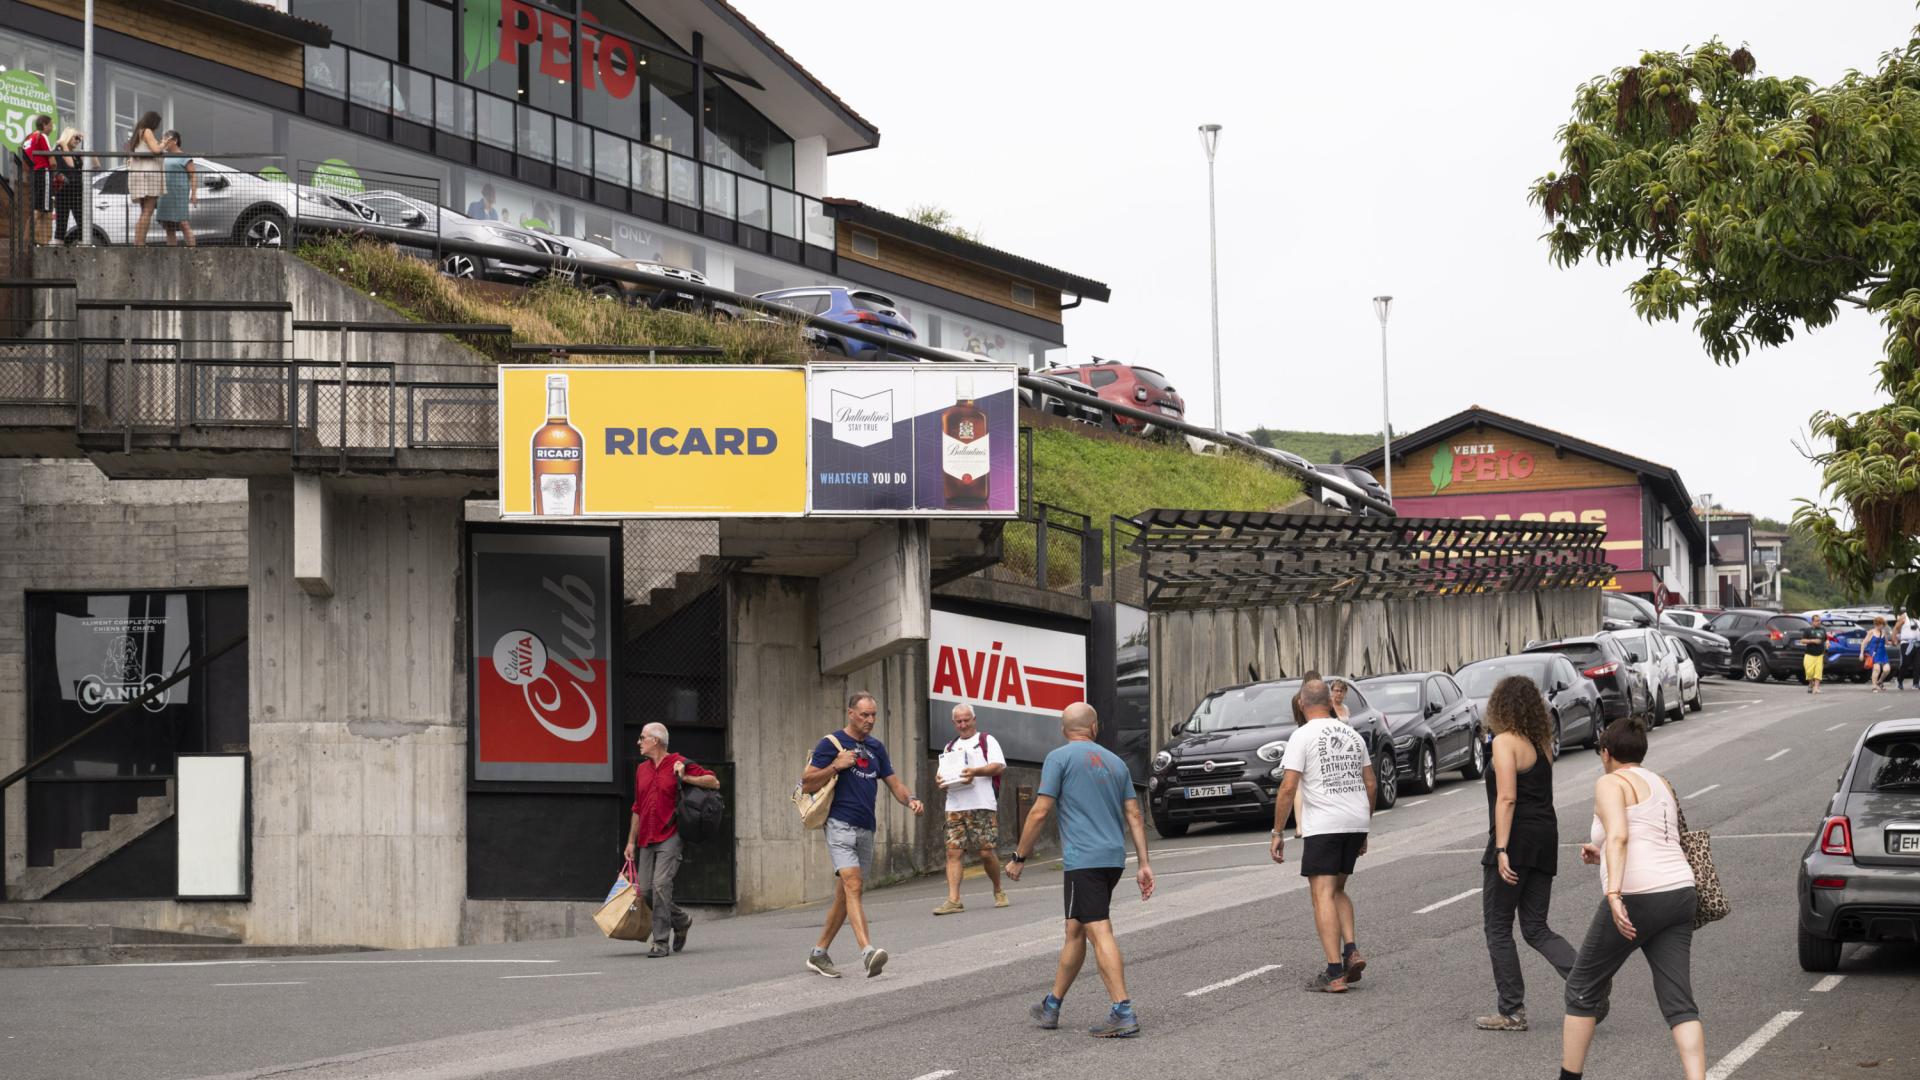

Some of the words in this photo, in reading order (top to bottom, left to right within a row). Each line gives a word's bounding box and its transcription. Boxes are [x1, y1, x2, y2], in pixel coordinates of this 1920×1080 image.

[619, 224, 653, 245] ONLY
[836, 406, 889, 422] Ballantine's
[848, 423, 861, 432] STAY
[863, 423, 878, 432] TRUE
[605, 427, 778, 456] RICARD
[1453, 444, 1496, 455] VENTA
[537, 450, 579, 458] RICARD
[820, 472, 869, 485] WHATEVER
[872, 472, 891, 485] YOU
[894, 472, 907, 485] DO
[504, 649, 519, 681] Club
[523, 574, 598, 742] Club
[1318, 736, 1327, 756] DEUS
[1331, 754, 1357, 762] TEMPLE
